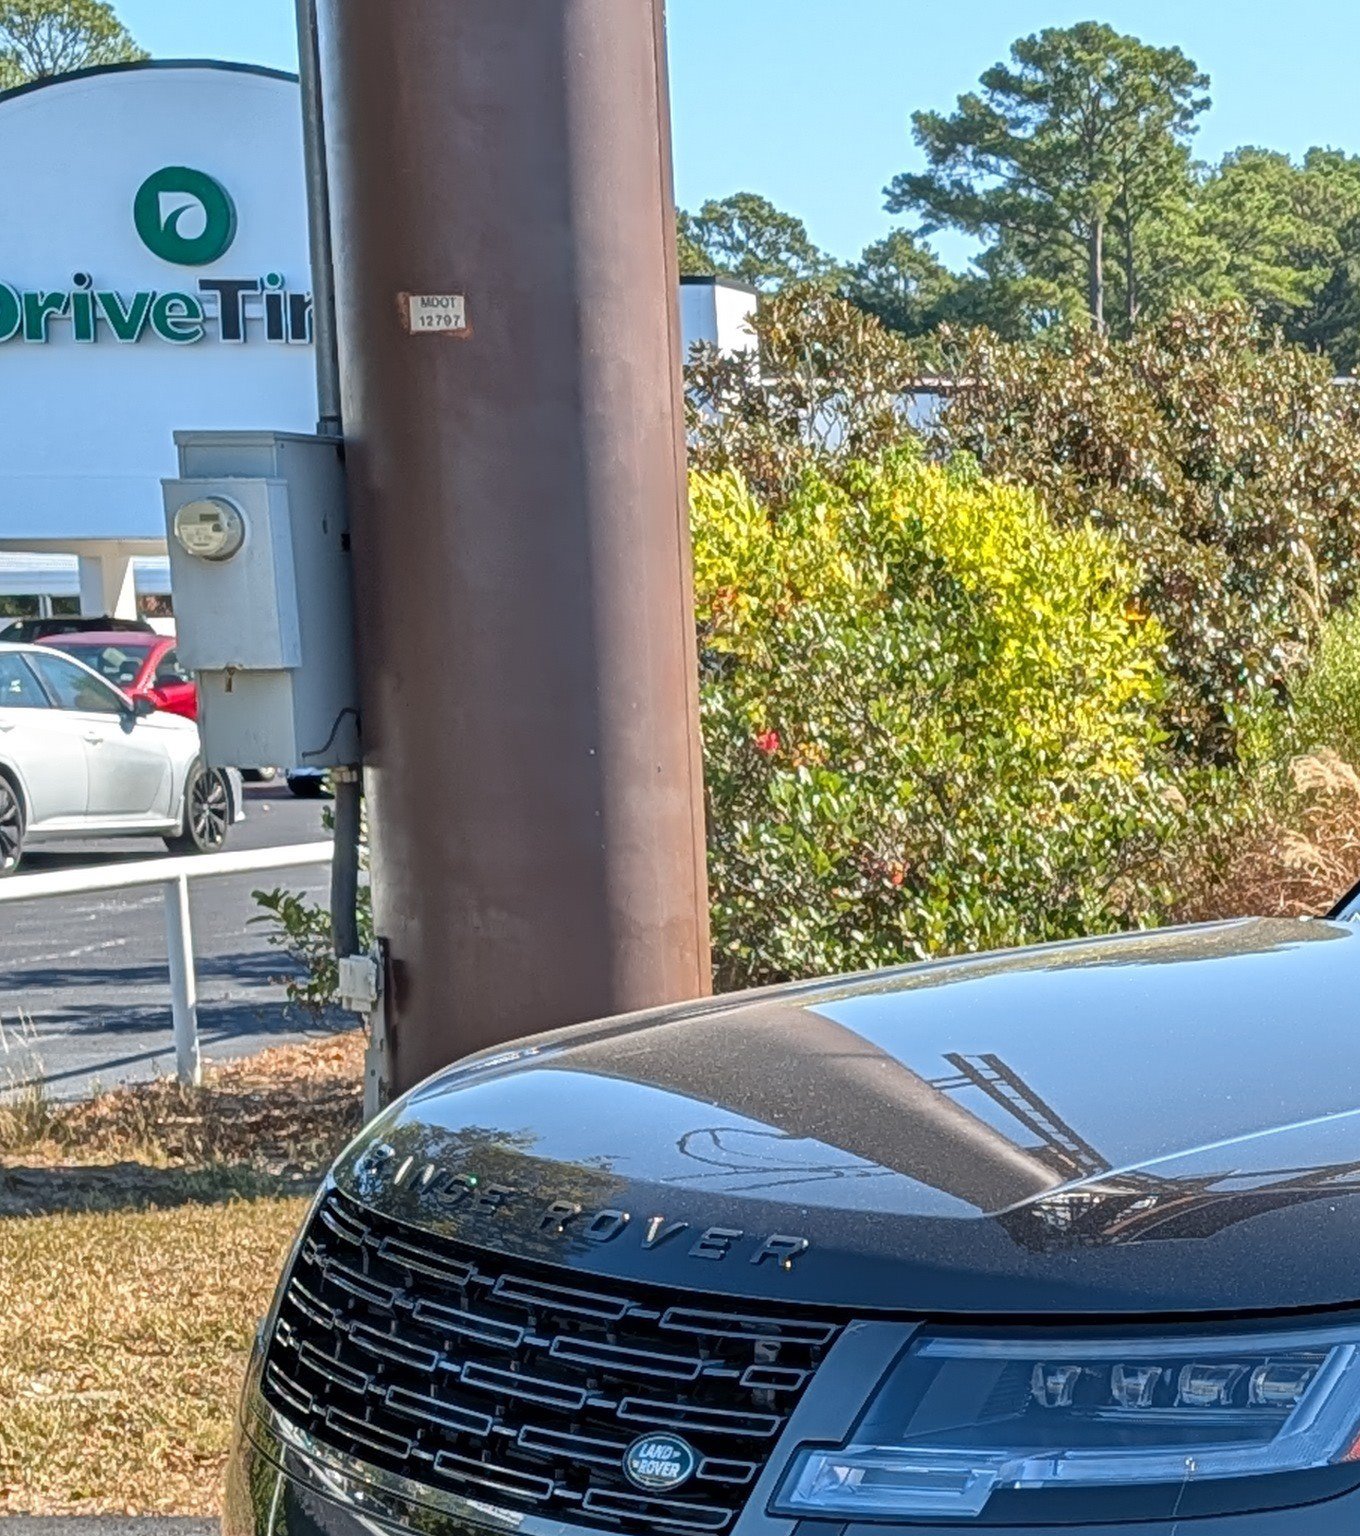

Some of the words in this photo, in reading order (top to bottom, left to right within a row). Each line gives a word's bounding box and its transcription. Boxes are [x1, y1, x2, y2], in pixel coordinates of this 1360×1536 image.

[540, 1199, 810, 1269] ROVER
[638, 1443, 674, 1460] LAND
[638, 1459, 680, 1477] ROVER
